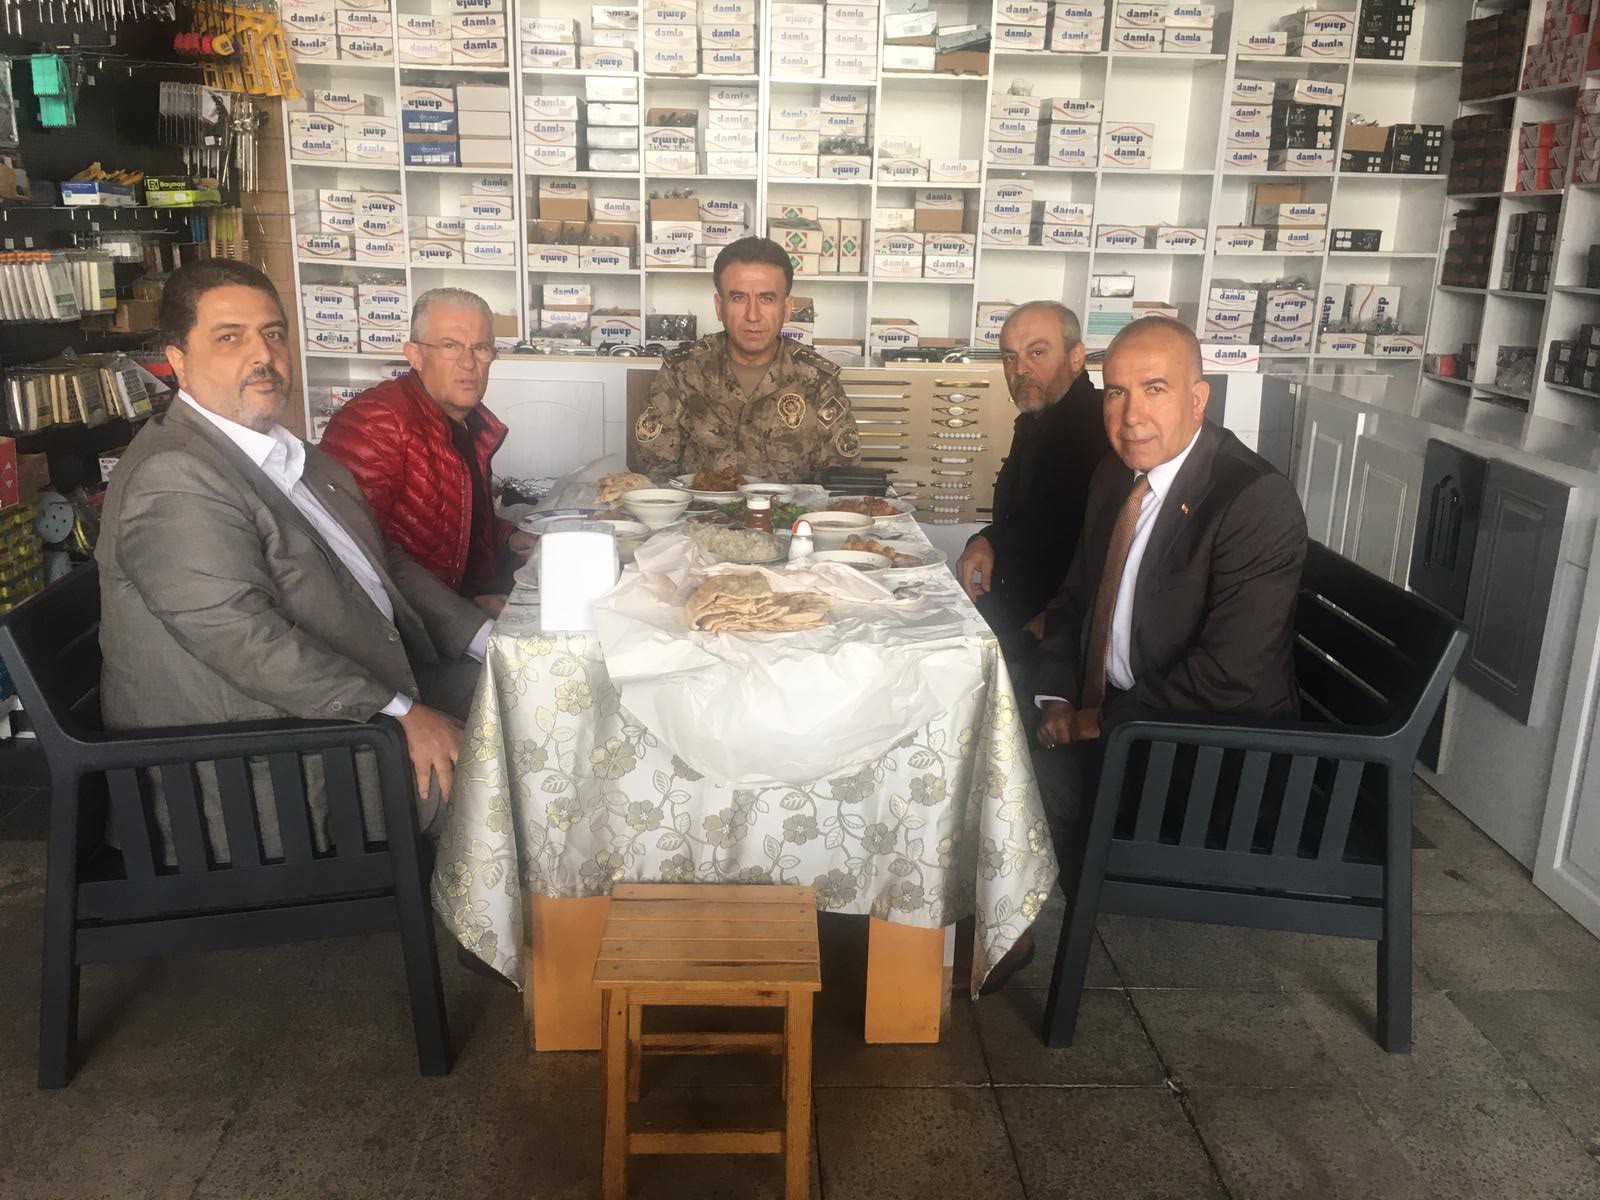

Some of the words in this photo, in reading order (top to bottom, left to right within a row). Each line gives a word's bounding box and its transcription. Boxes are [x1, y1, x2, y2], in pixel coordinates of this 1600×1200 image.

[713, 4, 741, 13] damla
[1066, 9, 1092, 17] damla
[1174, 8, 1201, 16] damla
[291, 14, 325, 22] damla
[657, 11, 686, 20] damla
[836, 9, 863, 18] damla
[1127, 10, 1158, 19] damla
[348, 14, 377, 23] damla
[462, 17, 496, 26] damla
[408, 19, 441, 28] daml
[655, 28, 683, 37] damla
[712, 29, 740, 38] damla
[781, 32, 809, 41] damla
[1004, 30, 1032, 38] damla
[1062, 32, 1088, 40] damla
[835, 34, 863, 43] damla
[1123, 34, 1155, 42] damla
[1174, 34, 1201, 42] damla
[1249, 36, 1276, 44] damla
[463, 40, 497, 50] damla
[1312, 39, 1343, 48] damla
[655, 52, 683, 61] damla
[713, 54, 741, 62] damla
[780, 57, 808, 65] damla
[835, 59, 863, 67] damla
[1307, 86, 1332, 94] damla
[718, 91, 749, 100] damla
[830, 94, 856, 102] damla
[409, 100, 441, 109] damla
[534, 98, 565, 106] damla
[1003, 107, 1030, 116] dam
[828, 117, 854, 125] damla
[300, 123, 334, 132] dam
[534, 124, 565, 133] damla
[999, 123, 1025, 131] damla
[359, 128, 386, 138] daml
[1060, 128, 1086, 136] damla
[1235, 130, 1260, 138] damla
[1111, 135, 1143, 144] damla
[303, 140, 331, 149] damla
[534, 147, 565, 157] damla
[996, 146, 1022, 154] damla
[1059, 149, 1085, 157] damla
[1114, 148, 1145, 157] damla
[832, 166, 860, 175] damla
[482, 178, 508, 186] damla
[550, 182, 576, 190] damla
[926, 192, 952, 201] damla
[604, 203, 631, 211] damla
[707, 200, 738, 210] damla
[994, 205, 1020, 213] damla
[473, 206, 501, 215] damla
[1290, 207, 1315, 215] damla
[329, 216, 354, 225] daml
[363, 220, 389, 229] dam
[436, 221, 465, 229] damla
[475, 223, 502, 231] damla
[991, 227, 1022, 235] damla
[1053, 229, 1083, 238] damla
[1288, 233, 1309, 241] daml
[307, 240, 340, 248] damla
[1106, 236, 1137, 245] damla
[366, 243, 394, 252] damla
[474, 246, 501, 254] damla
[889, 241, 914, 251] dam
[933, 242, 964, 252] damla
[420, 250, 452, 259] damla
[540, 254, 568, 262] damla
[592, 256, 619, 265] damla
[933, 260, 965, 268] damla
[553, 288, 579, 296] damla
[315, 296, 342, 304] damla
[372, 295, 399, 304] damla
[1220, 293, 1245, 301] damla
[316, 311, 343, 320] damla
[368, 312, 400, 320] damla
[1322, 297, 1335, 326] dam
[550, 313, 576, 322] damla
[990, 314, 1006, 323] mla
[1215, 314, 1240, 322] daml
[1274, 314, 1299, 322] daml
[601, 327, 631, 336] damla
[781, 331, 803, 339] dam
[316, 334, 349, 343] dala
[1271, 334, 1302, 343] damla
[1215, 350, 1247, 358] damla
[1383, 346, 1413, 354] damla
